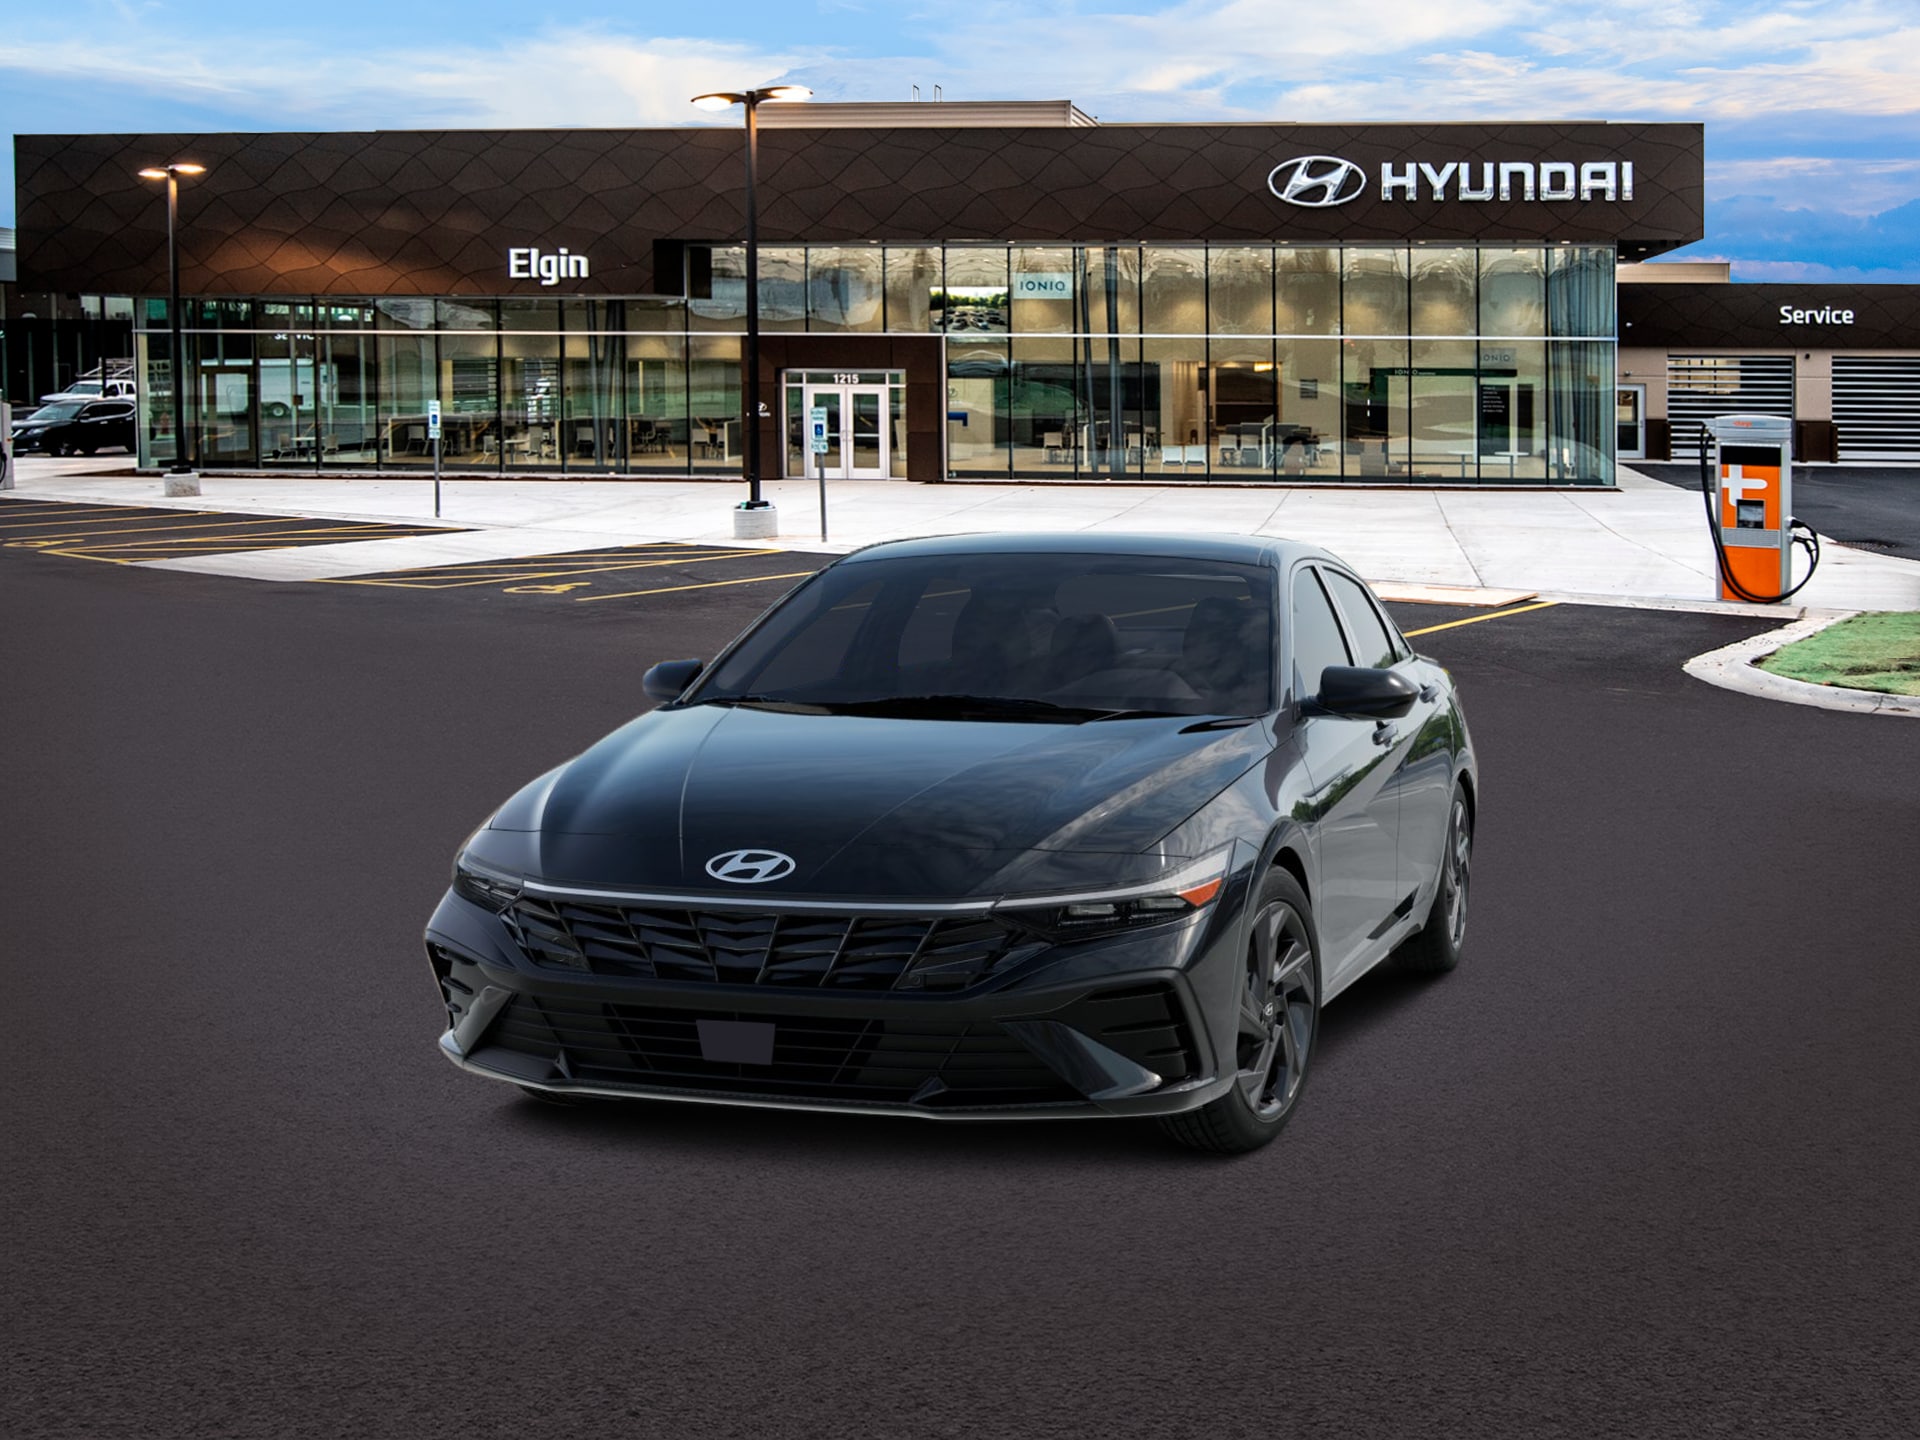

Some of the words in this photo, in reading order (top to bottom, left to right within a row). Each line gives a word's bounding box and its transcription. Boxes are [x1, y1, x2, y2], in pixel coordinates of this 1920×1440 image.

[1381, 161, 1634, 201] HYUNDAI
[508, 247, 589, 286] Elgin
[1020, 280, 1066, 292] IONIQ
[1779, 305, 1854, 325] Service
[833, 373, 860, 384] 1215
